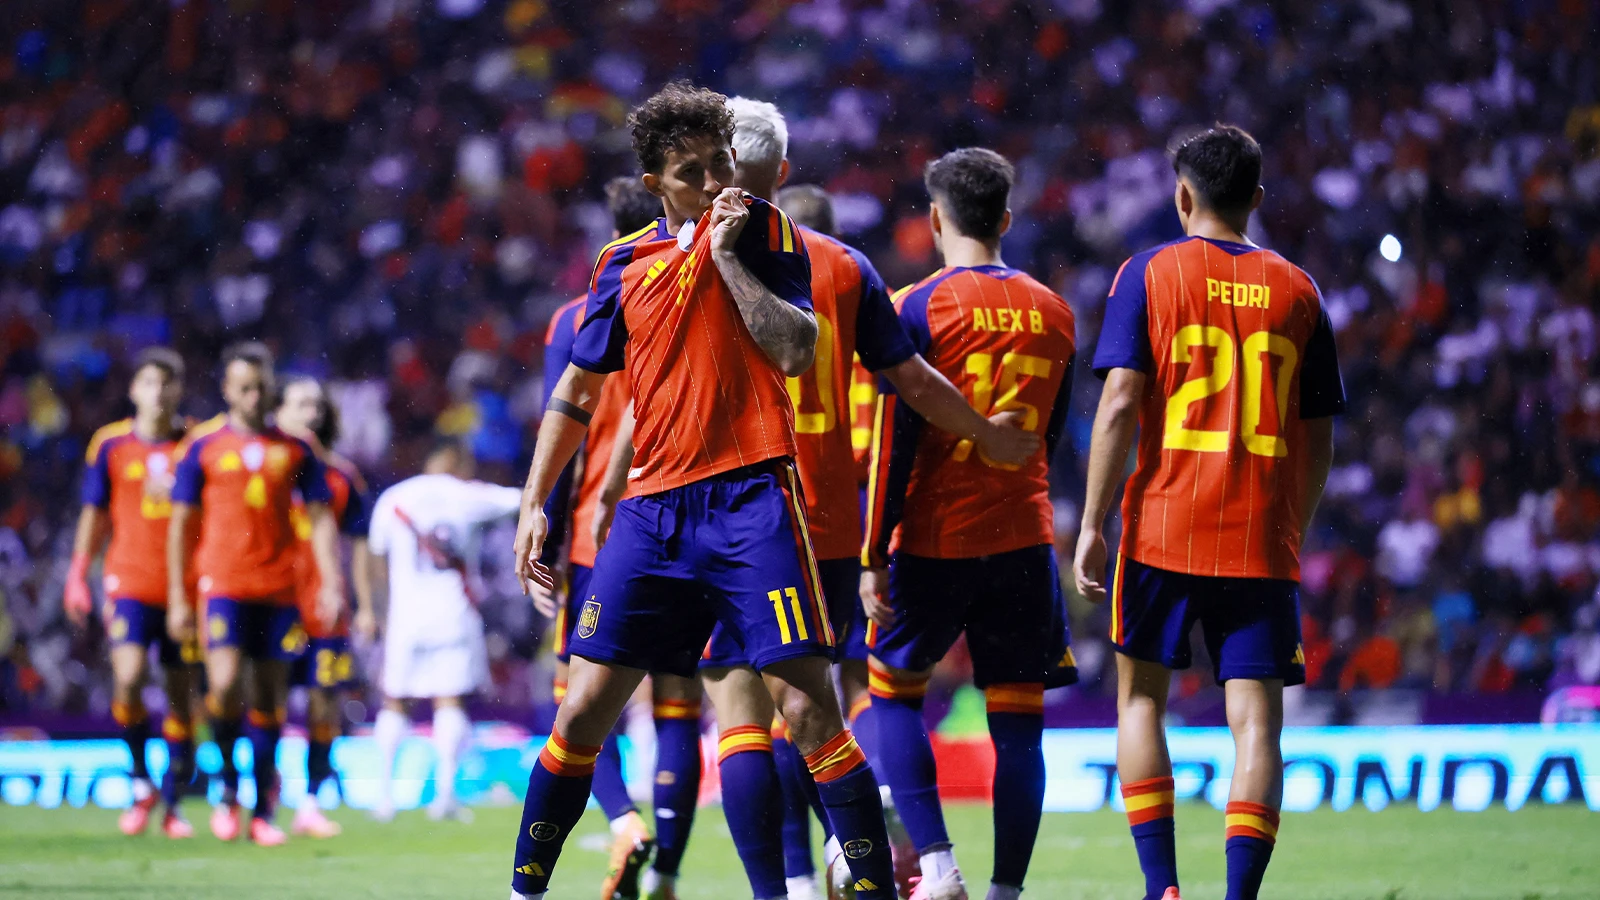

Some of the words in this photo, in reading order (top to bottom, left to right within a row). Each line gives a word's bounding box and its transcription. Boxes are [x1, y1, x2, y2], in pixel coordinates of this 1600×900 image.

[1206, 278, 1270, 309] PEDRI
[973, 307, 1024, 332] ALEX
[1163, 324, 1298, 457] 20
[767, 586, 808, 645] 11
[1084, 757, 1589, 802] TRONDA
